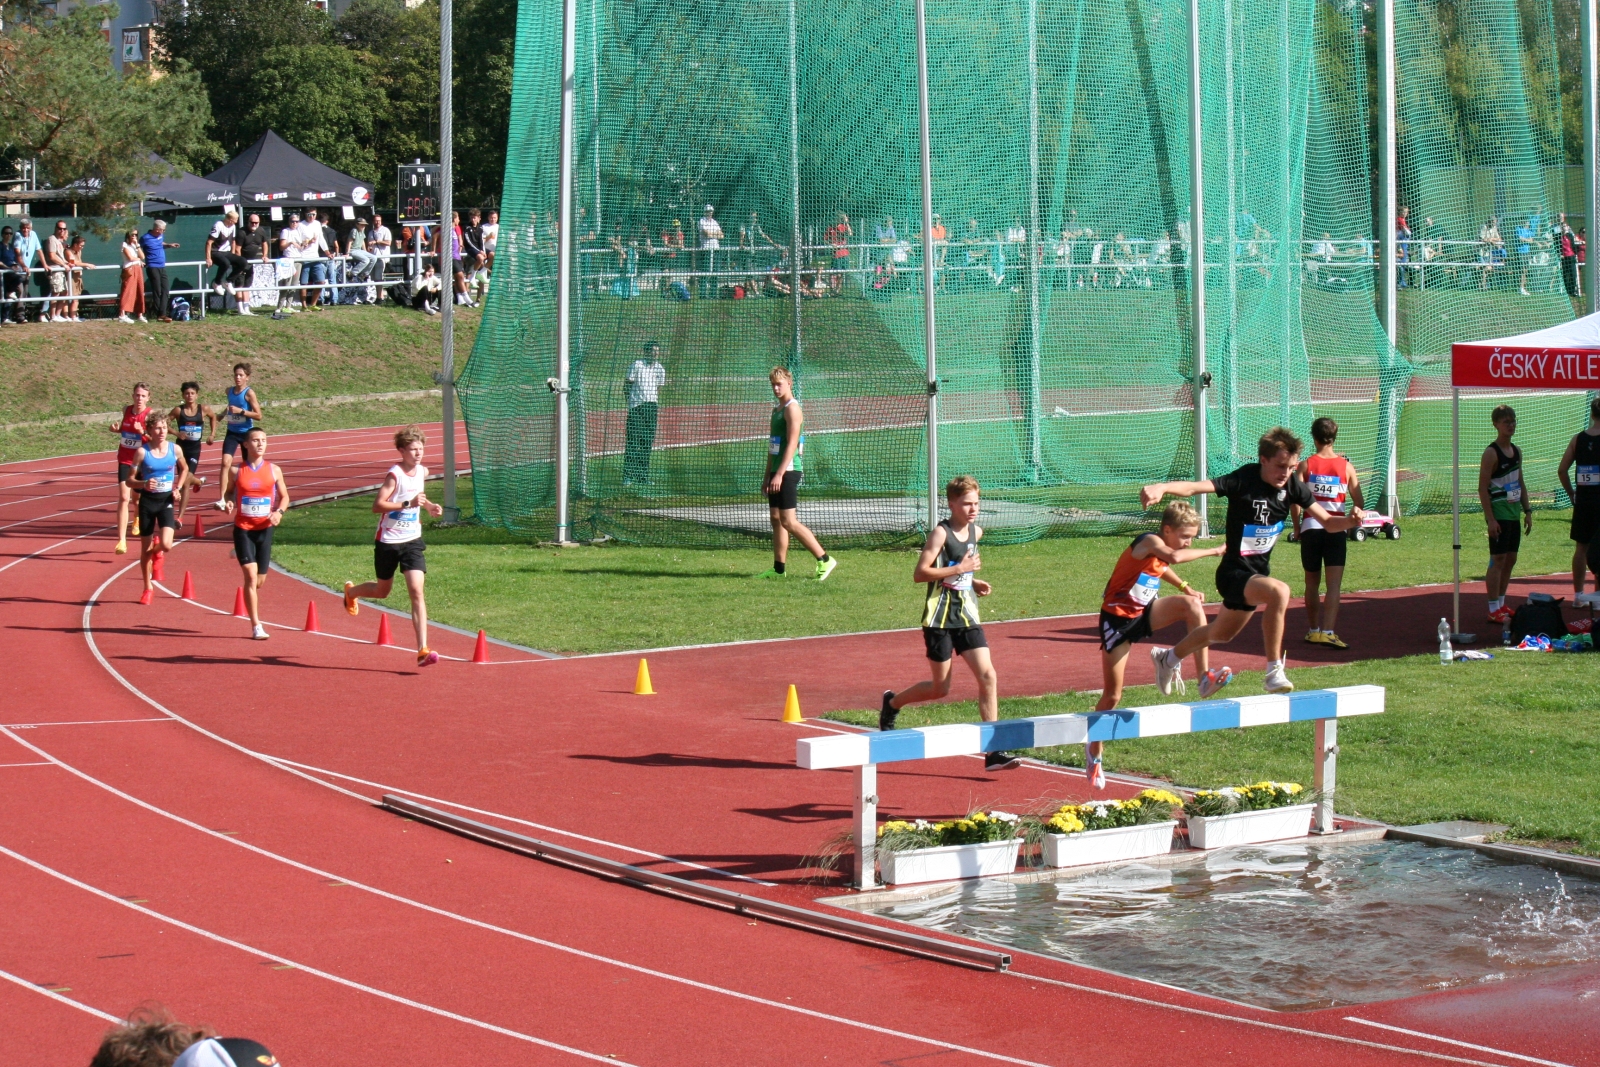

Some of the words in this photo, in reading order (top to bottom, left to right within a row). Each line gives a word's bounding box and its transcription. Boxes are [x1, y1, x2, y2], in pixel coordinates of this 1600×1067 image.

[412, 174, 417, 187] D
[425, 173, 431, 187] H
[1489, 347, 1548, 379] ČESKÝ
[1552, 354, 1600, 380] ATLE
[124, 438, 137, 447] 497
[1314, 483, 1332, 493] 544
[1254, 537, 1273, 546] 537
